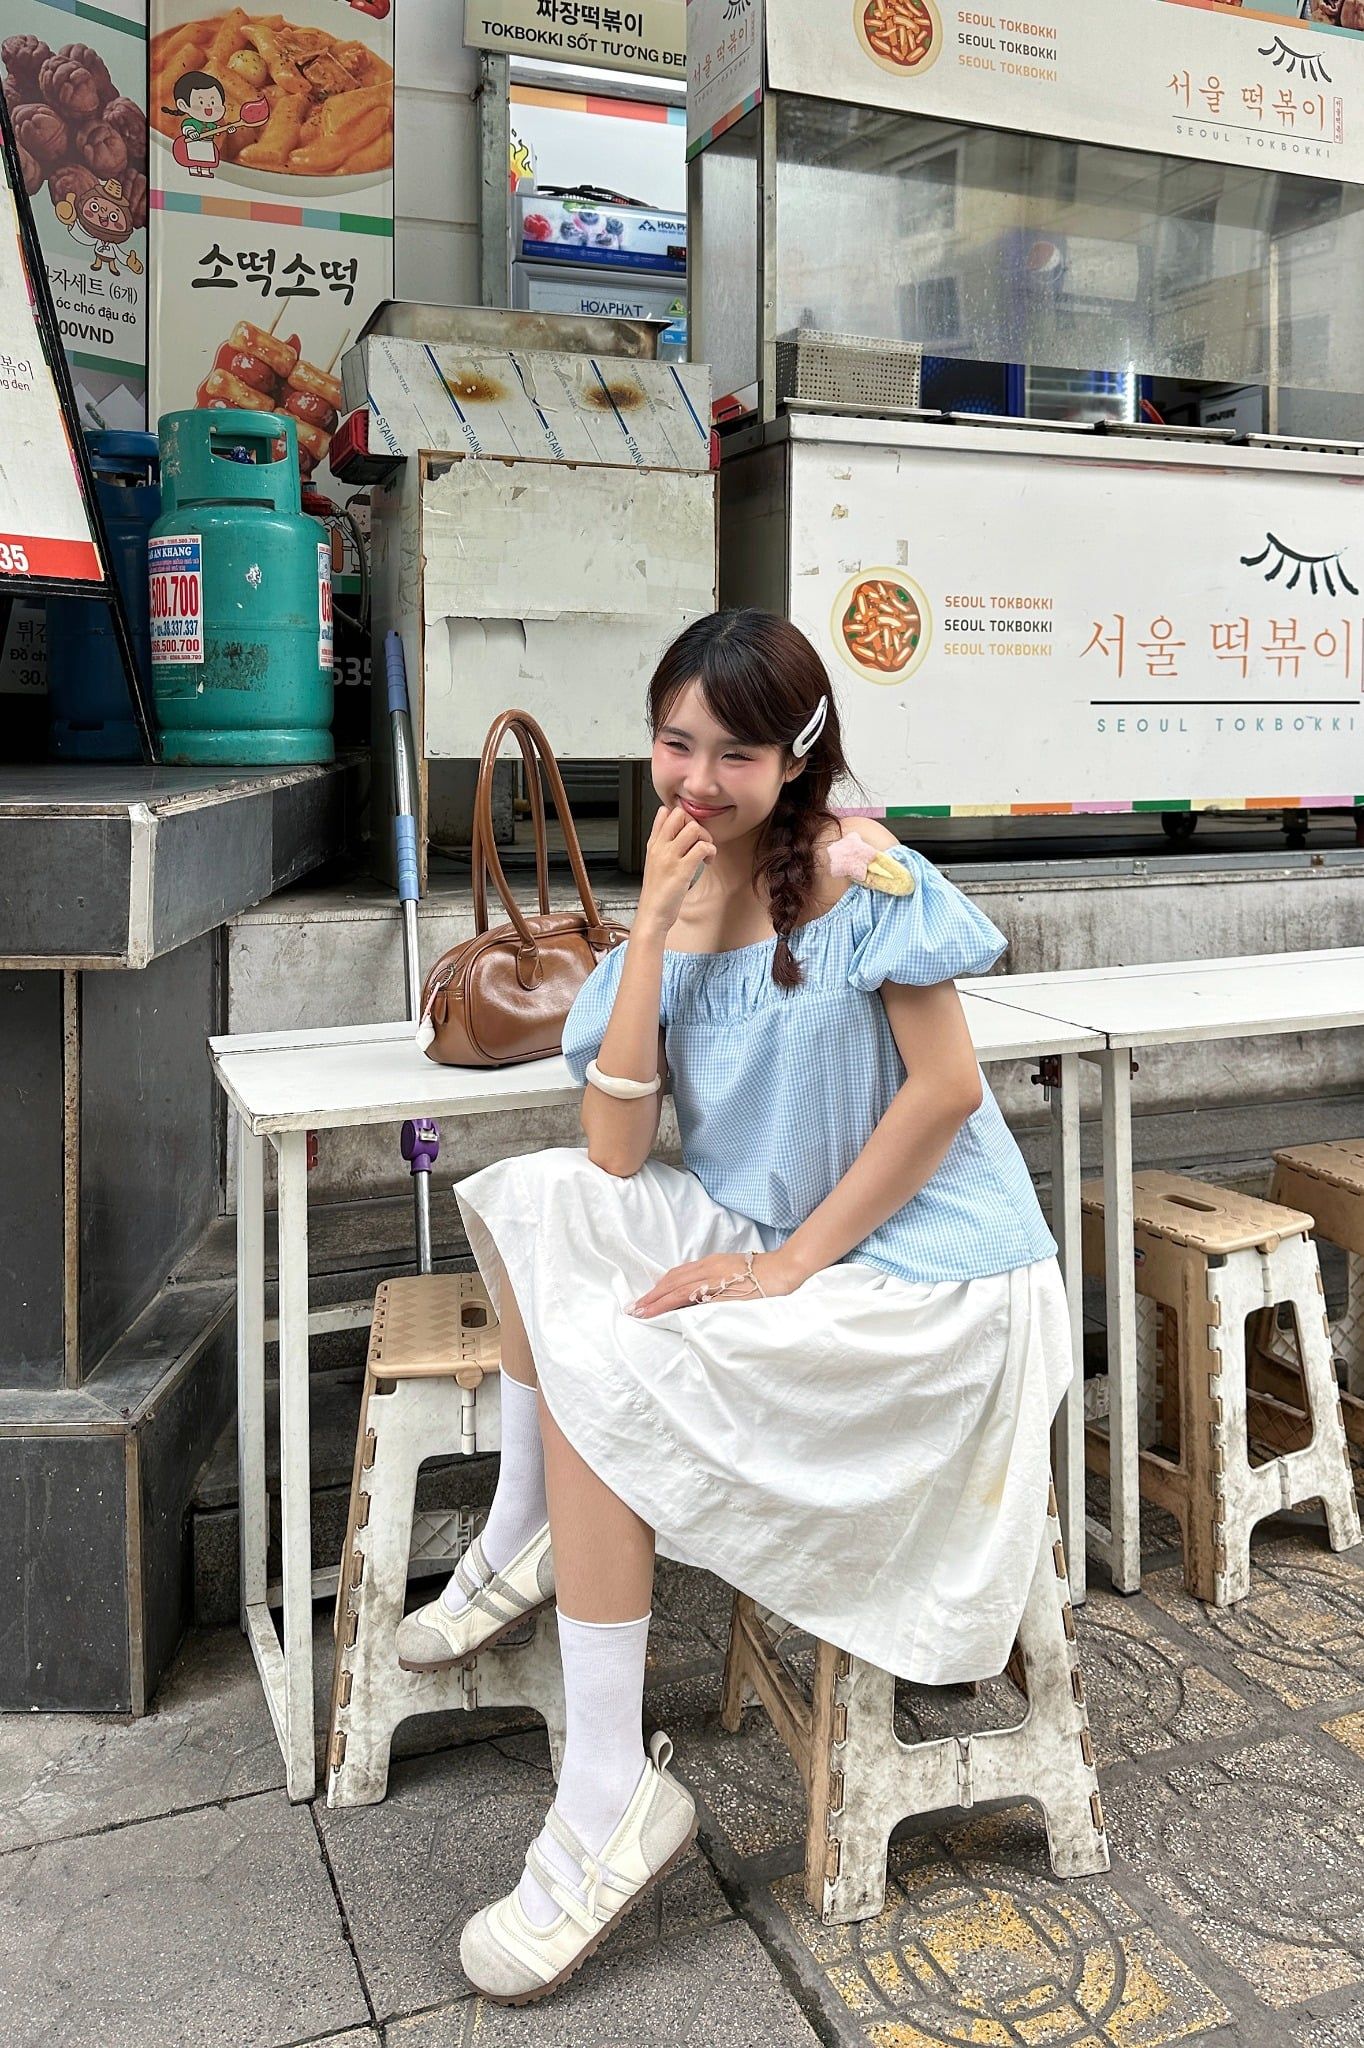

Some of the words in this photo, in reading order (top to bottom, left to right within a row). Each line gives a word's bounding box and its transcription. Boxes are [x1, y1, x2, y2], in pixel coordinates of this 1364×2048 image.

[536, 0, 644, 37] 짜장떡볶이
[957, 11, 996, 29] SEOUL
[999, 18, 1057, 40] TOKBOKKI
[481, 20, 564, 47] TOKBOKKI
[567, 33, 598, 52] SỐT
[600, 40, 660, 63] TƯƠNG
[957, 32, 996, 50] SEOUL
[999, 39, 1057, 61] TOKBOKKI
[958, 54, 997, 71] SEOUL
[1000, 61, 1057, 82] TOKBOKKI
[1165, 70, 1225, 114] 서울
[1240, 83, 1325, 132] 떡볶이
[1176, 124, 1230, 142] SEOUL
[1246, 136, 1331, 158] TOKBOKKI
[191, 243, 358, 306] 소떡소떡
[109, 282, 138, 306] (6개)
[73, 302, 95, 315] chó
[98, 307, 119, 322] đậu
[121, 312, 137, 325] đỏ
[0, 543, 29, 572] 35
[162, 546, 192, 558] KHANG
[945, 595, 986, 609] SEOUL
[990, 596, 1053, 610] TOKBOKKI
[944, 618, 985, 632] SEOUL
[988, 619, 1052, 633] TOKBOKKI
[944, 642, 985, 656] SEOUL
[988, 643, 1052, 657] TOKBOKKI
[1079, 613, 1187, 679] 서울
[1209, 616, 1352, 680] 떡볶이
[1096, 717, 1188, 733] SEOUL
[1215, 716, 1355, 733] TOKBOKKI
